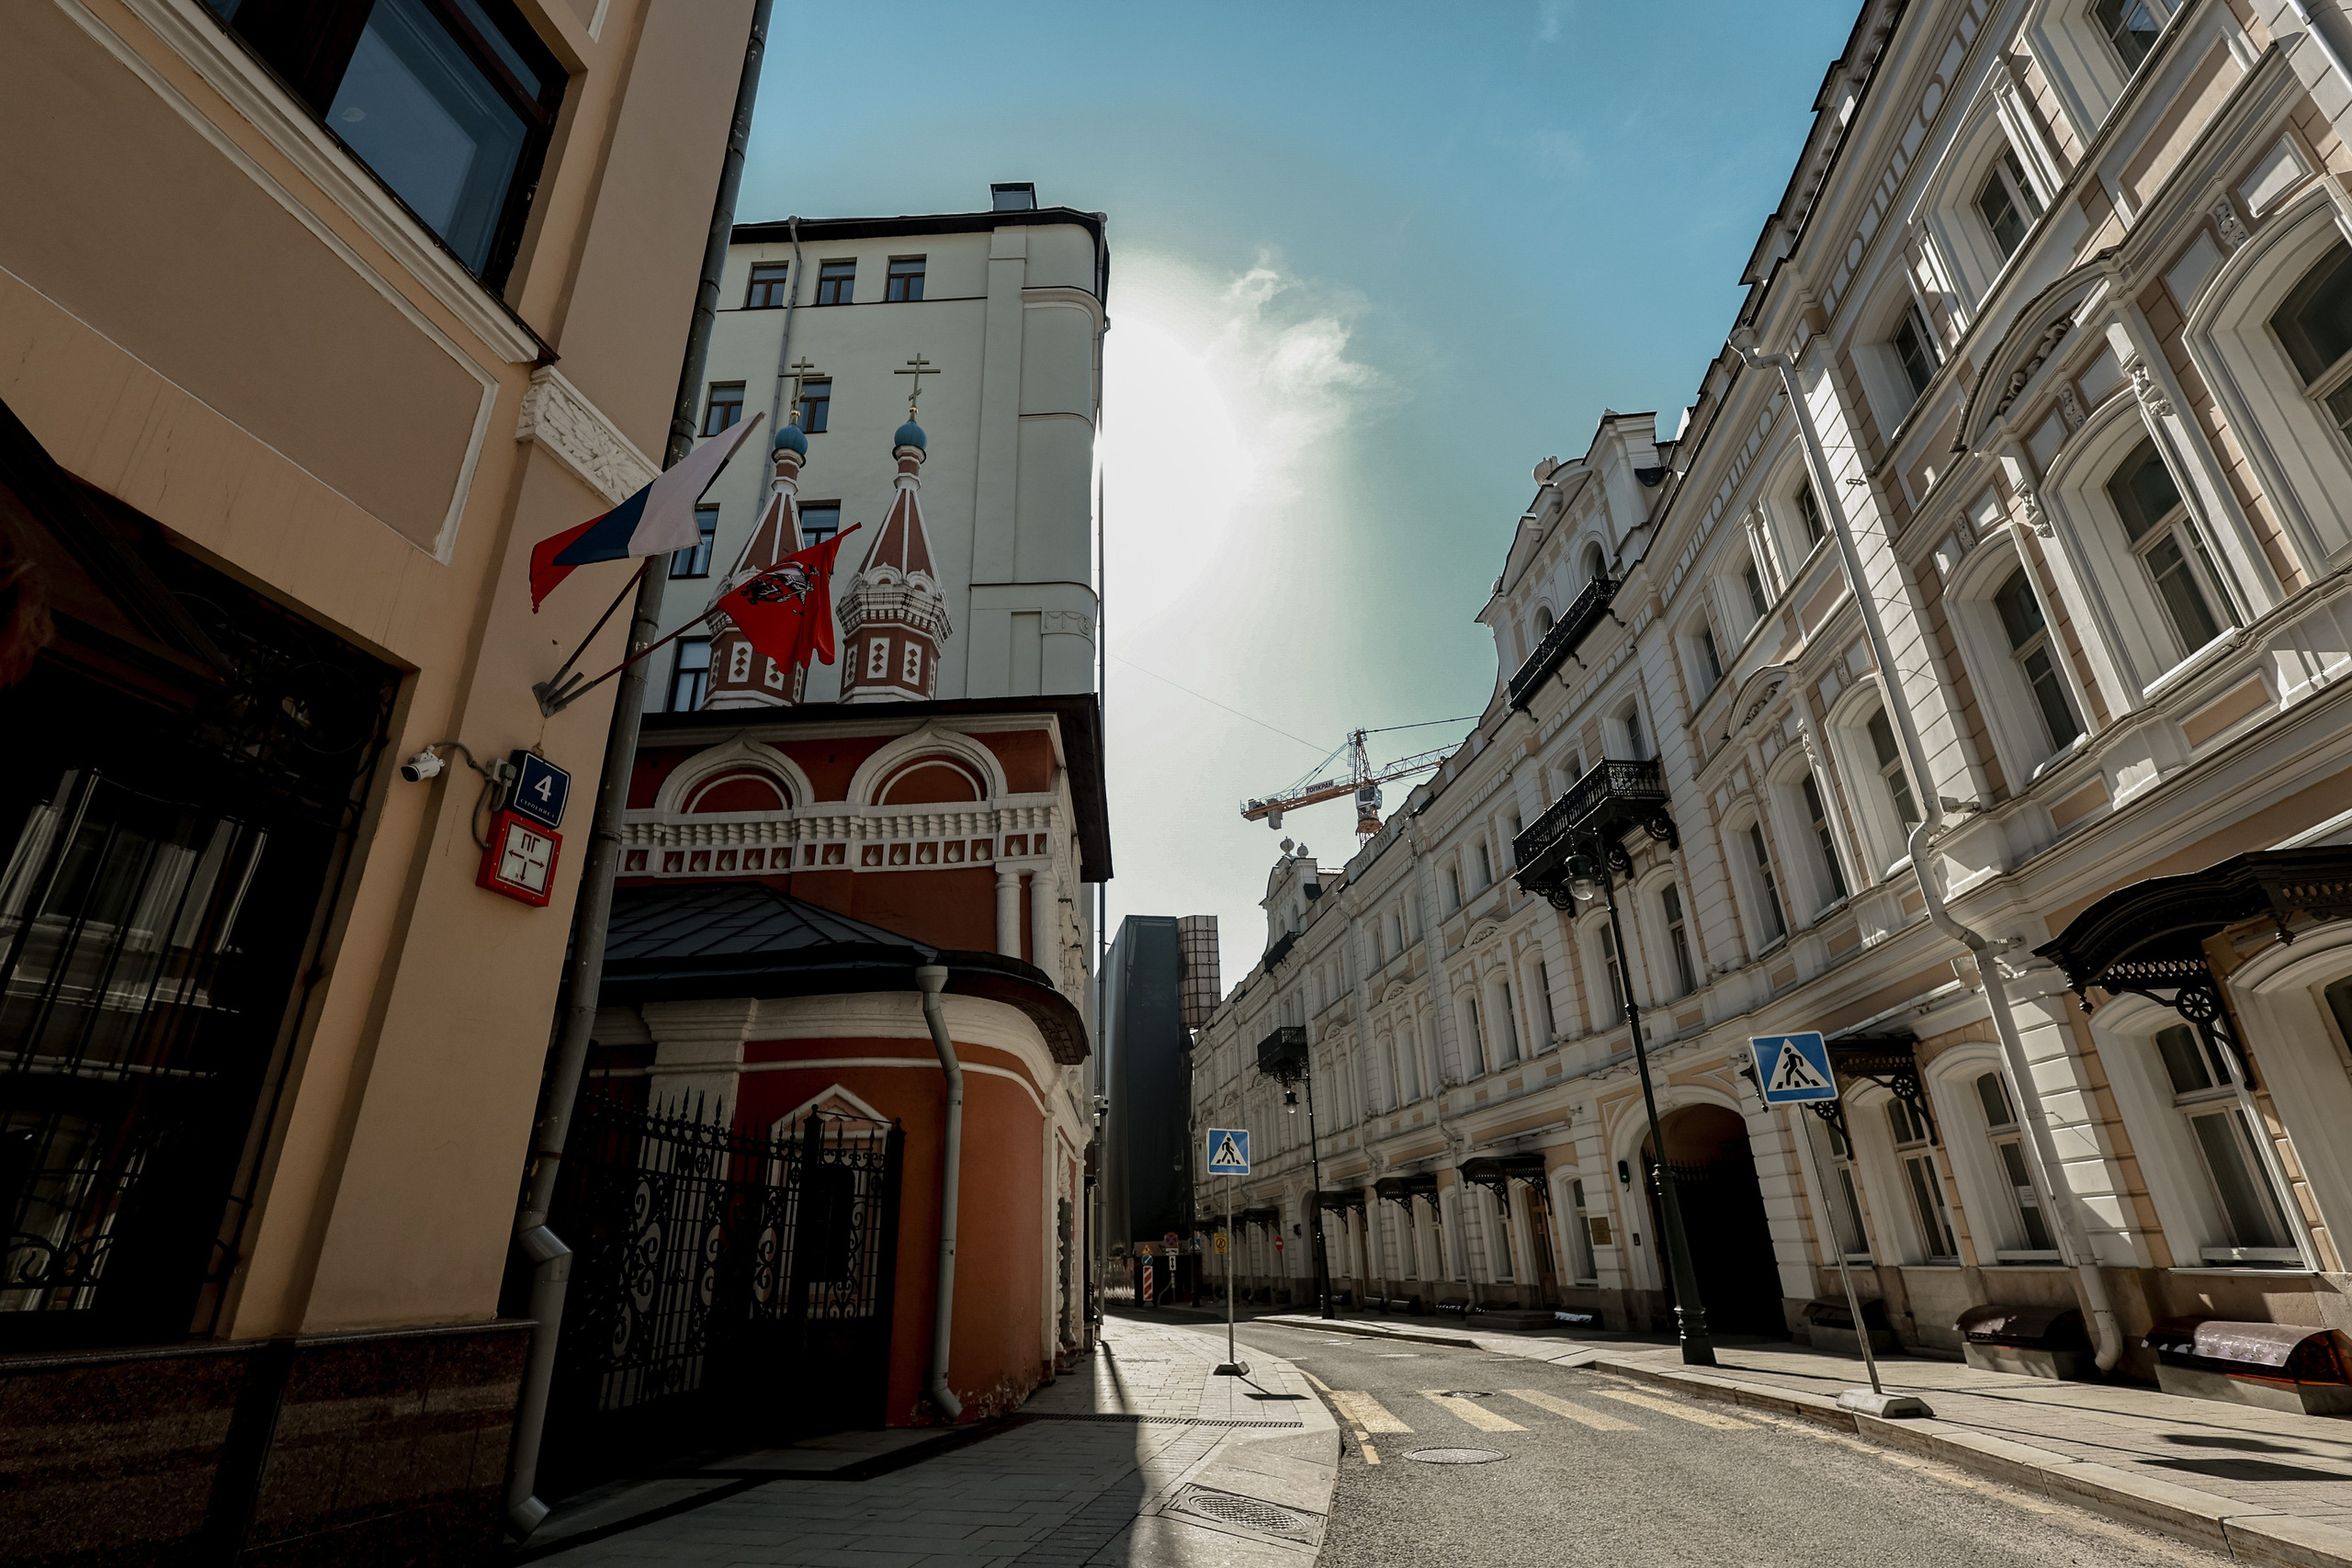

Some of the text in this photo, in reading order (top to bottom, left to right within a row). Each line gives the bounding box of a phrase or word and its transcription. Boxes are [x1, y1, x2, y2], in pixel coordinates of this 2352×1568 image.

[534, 775, 551, 802] 4
[1306, 782, 1333, 794] ТОПКРАН
[520, 798, 550, 817] СТРОЕНИЕ
[521, 833, 540, 852] ПГ
